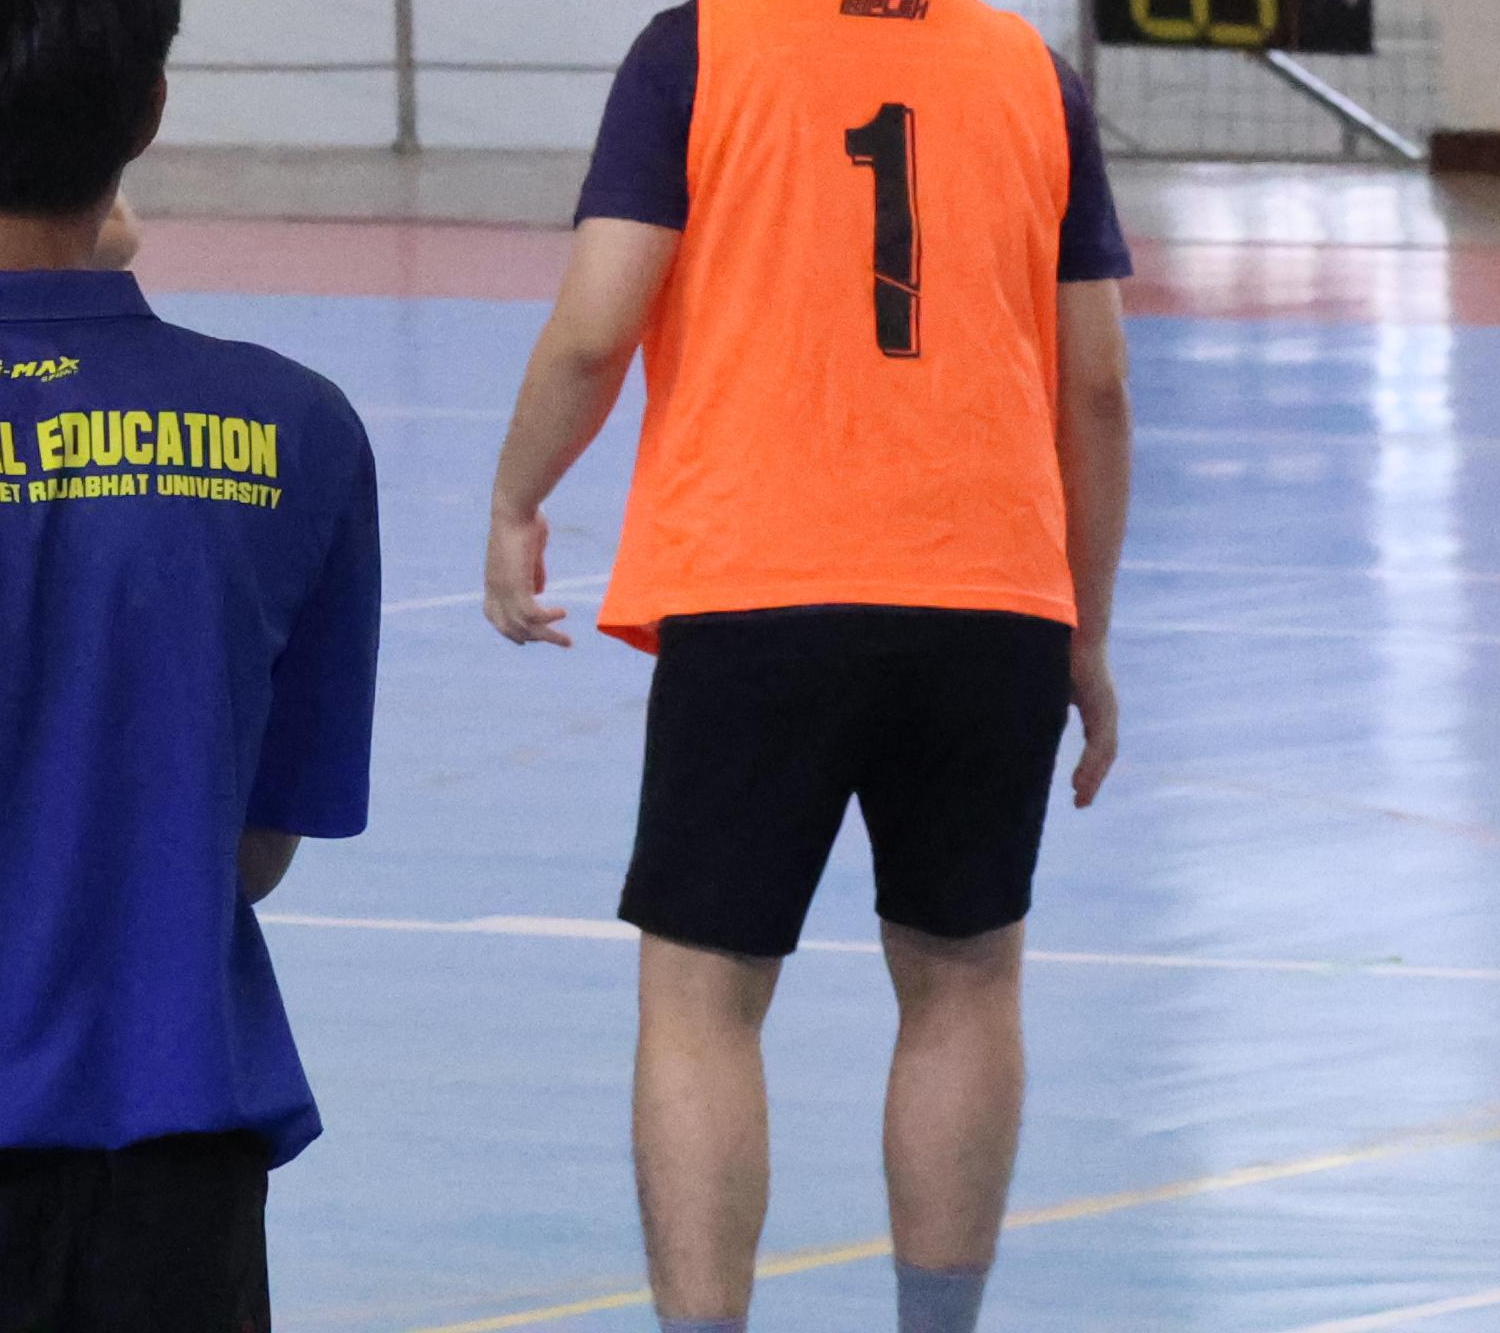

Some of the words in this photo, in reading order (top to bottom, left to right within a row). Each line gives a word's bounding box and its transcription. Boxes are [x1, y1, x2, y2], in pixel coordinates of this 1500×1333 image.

[845, 102, 922, 359] 1
[37, 410, 278, 479] EDUCATION
[157, 475, 282, 510] UNIVERSITY
